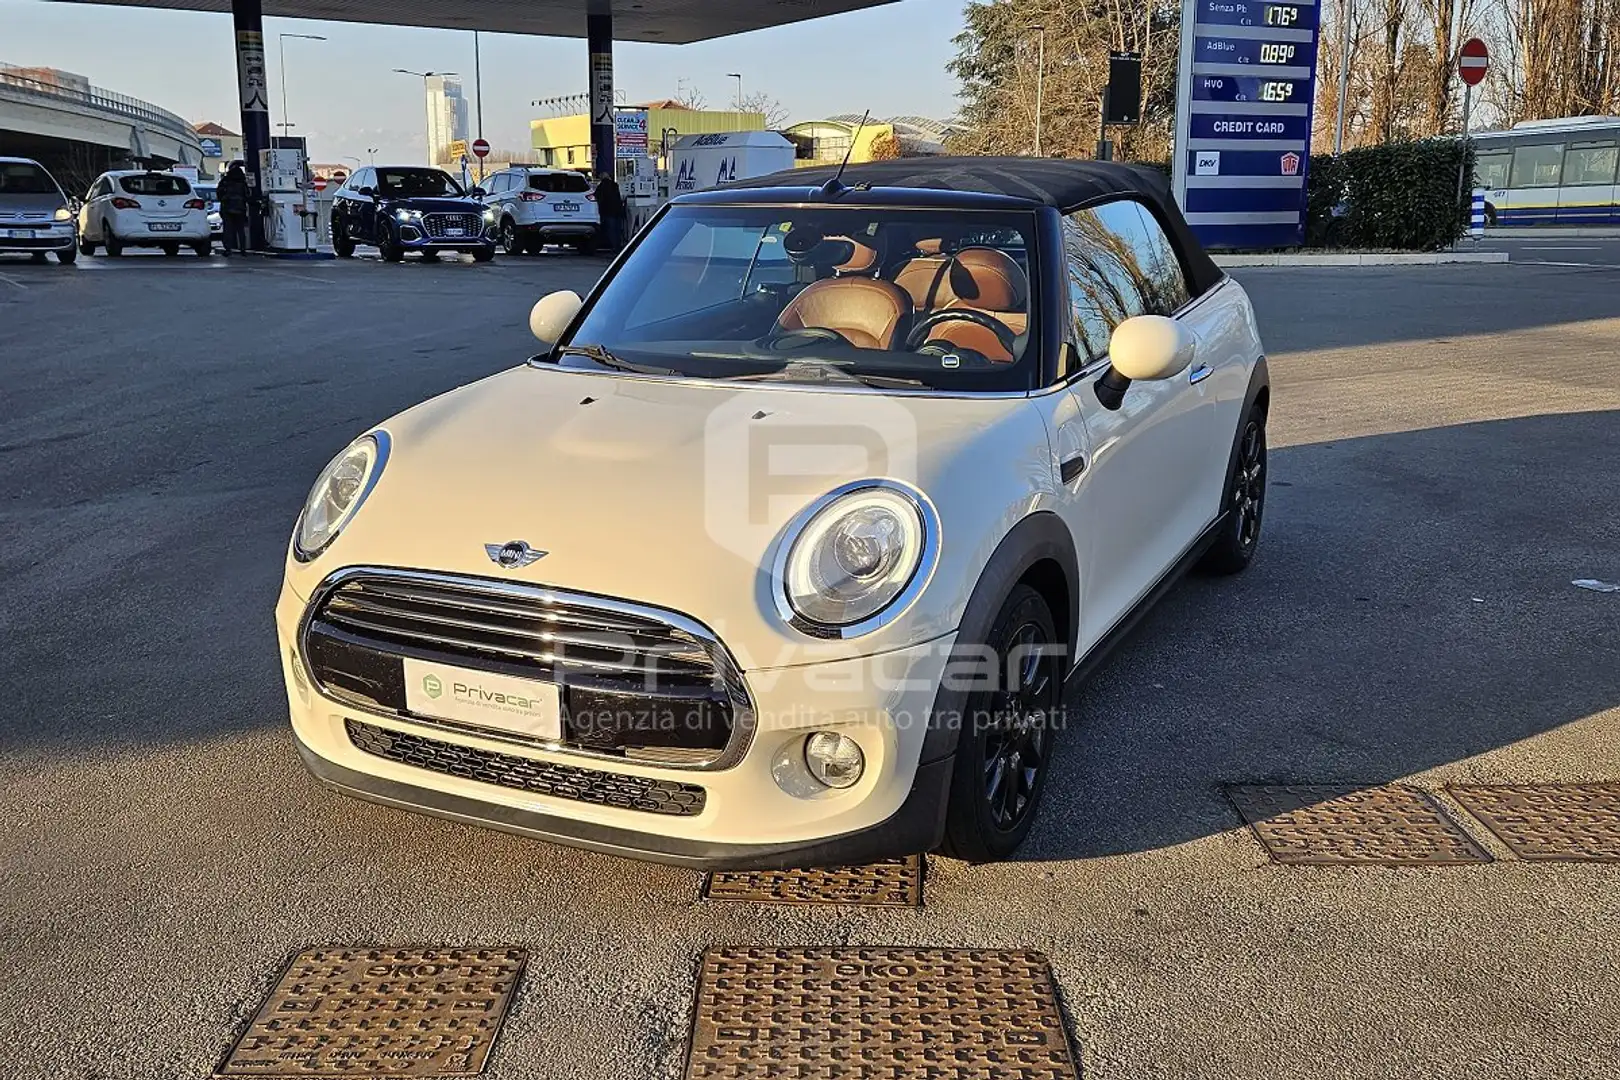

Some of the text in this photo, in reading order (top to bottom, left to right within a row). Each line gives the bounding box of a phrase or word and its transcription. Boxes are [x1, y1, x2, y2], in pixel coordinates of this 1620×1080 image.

[1209, 2, 1247, 13] Senza Pb
[1206, 41, 1235, 51] AdBlue
[1204, 79, 1223, 89] HVO
[1213, 121, 1285, 133] CREDIT CARD
[1199, 159, 1216, 168] DKV
[500, 549, 523, 559] MINI
[453, 682, 540, 709] Privacar
